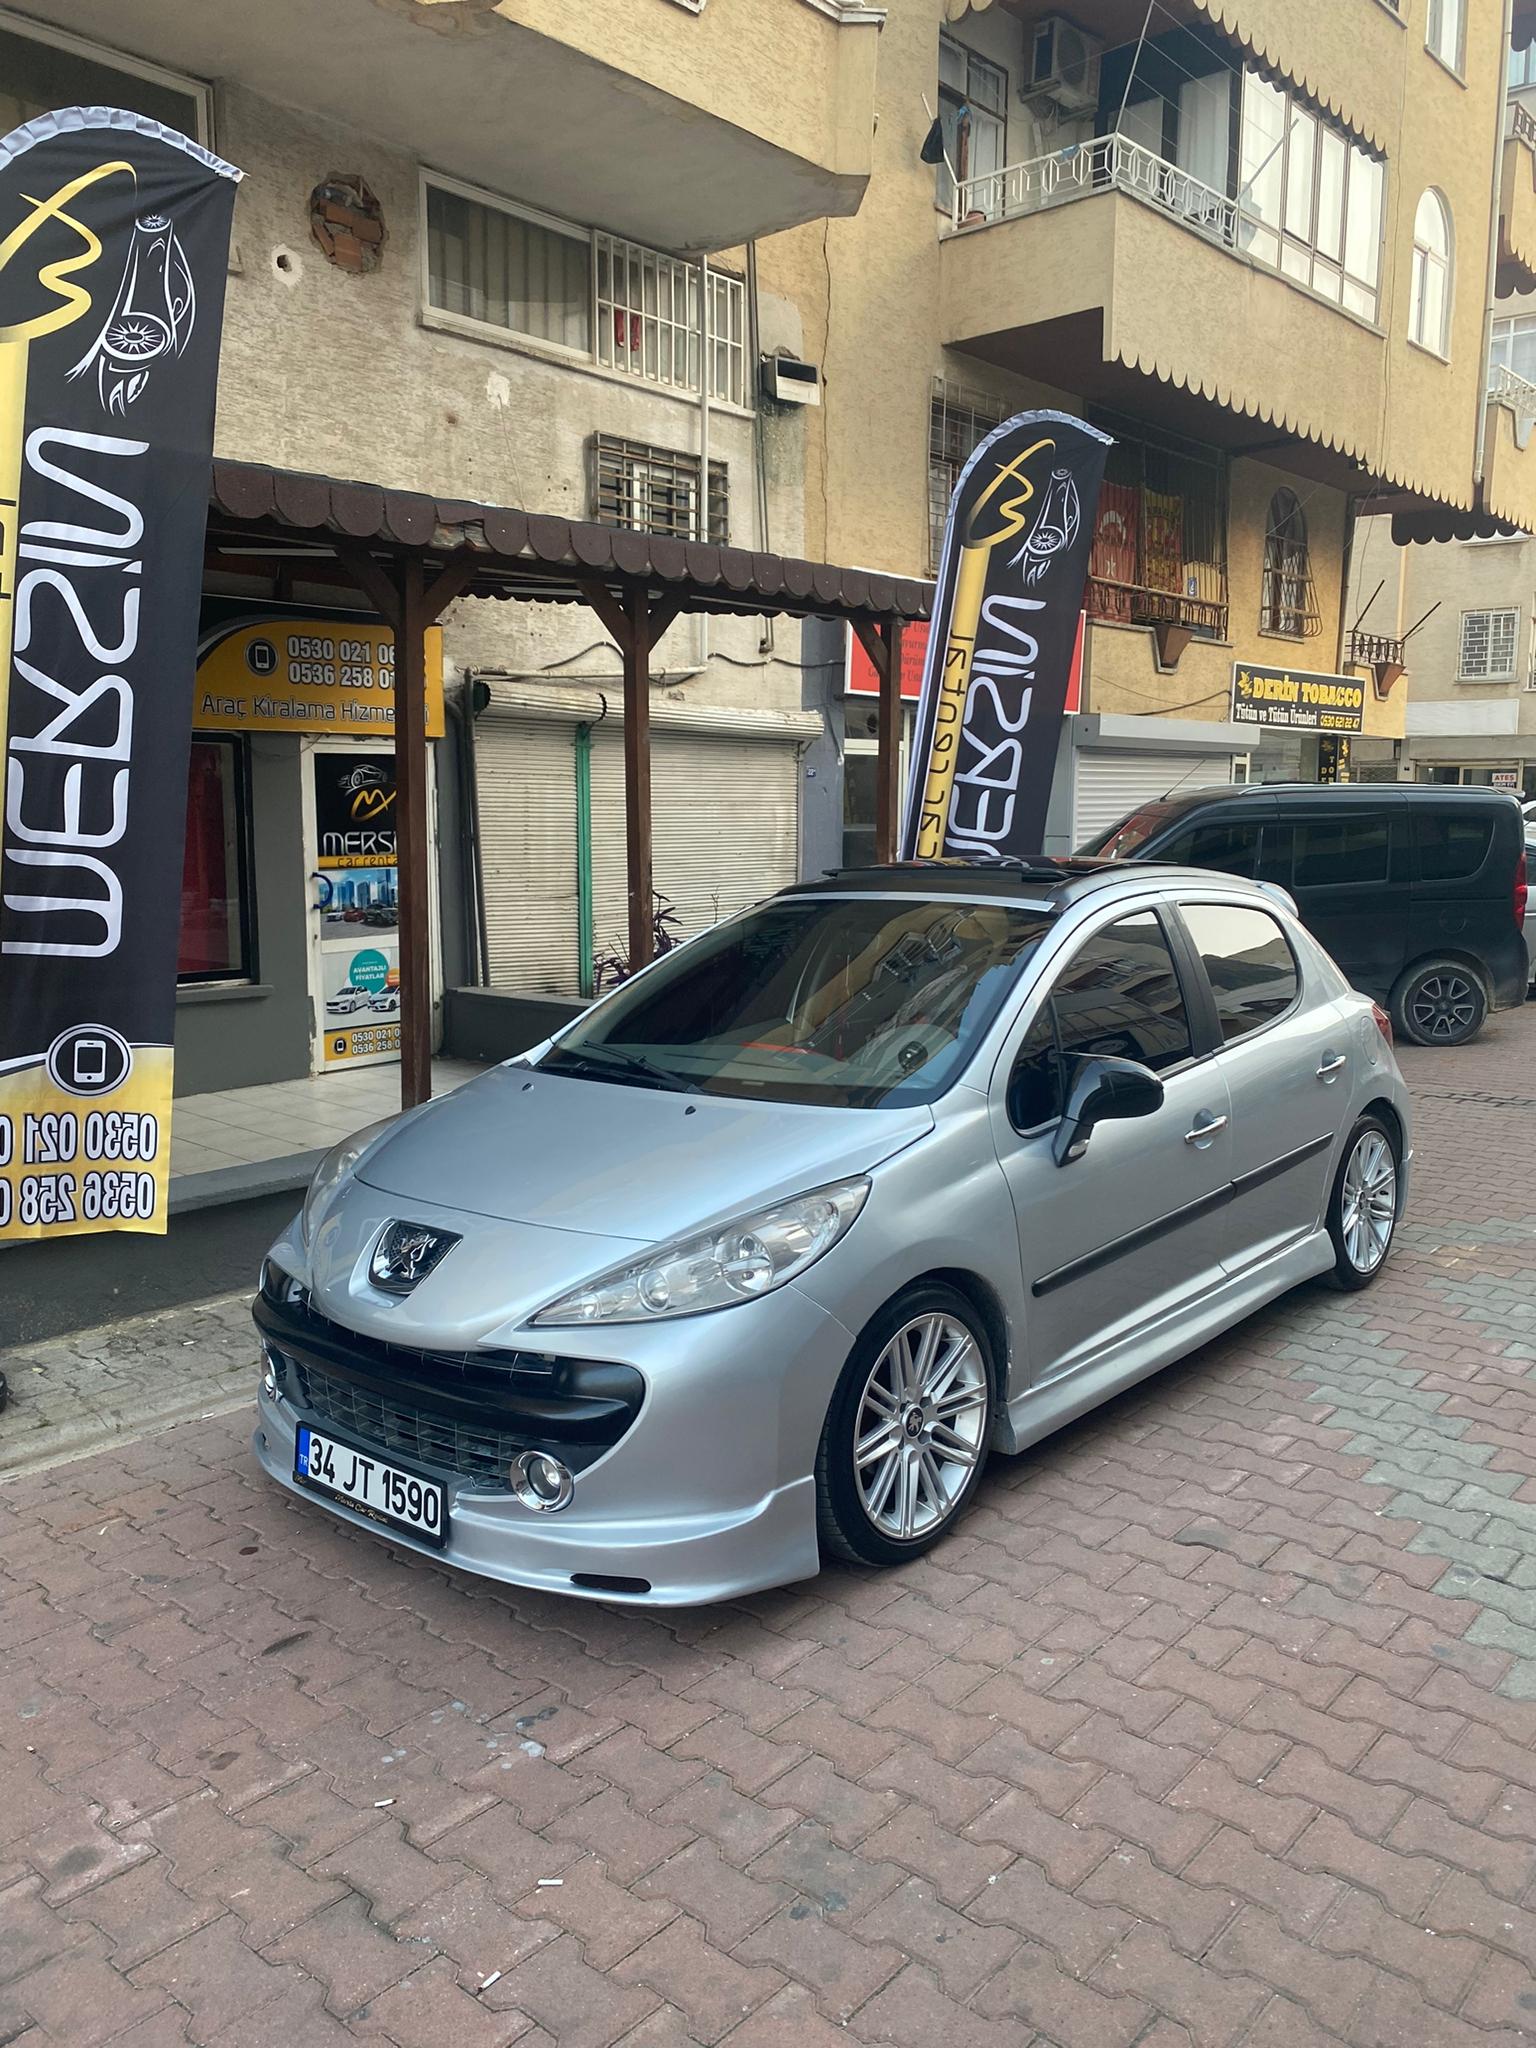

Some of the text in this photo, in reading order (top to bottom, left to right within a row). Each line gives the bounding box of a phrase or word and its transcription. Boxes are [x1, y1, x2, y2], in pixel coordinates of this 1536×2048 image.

[286, 636, 334, 660] 0530
[339, 641, 372, 664] 021
[288, 662, 336, 686] 0536
[339, 666, 374, 688] 258
[1252, 675, 1362, 708] DERİN TOBACCO
[201, 694, 247, 718] Araç
[253, 694, 336, 721] Kiralama
[1235, 703, 1258, 720] Tütün
[1259, 709, 1267, 722] ve
[1268, 706, 1289, 724] Tütün
[337, 856, 361, 867] car
[351, 1031, 374, 1043] 0530
[376, 1028, 392, 1040] 021
[351, 1041, 374, 1054] 0536
[376, 1039, 393, 1051] 258
[299, 1453, 308, 1468] TR
[309, 1438, 439, 1529] 34 JT 1590
